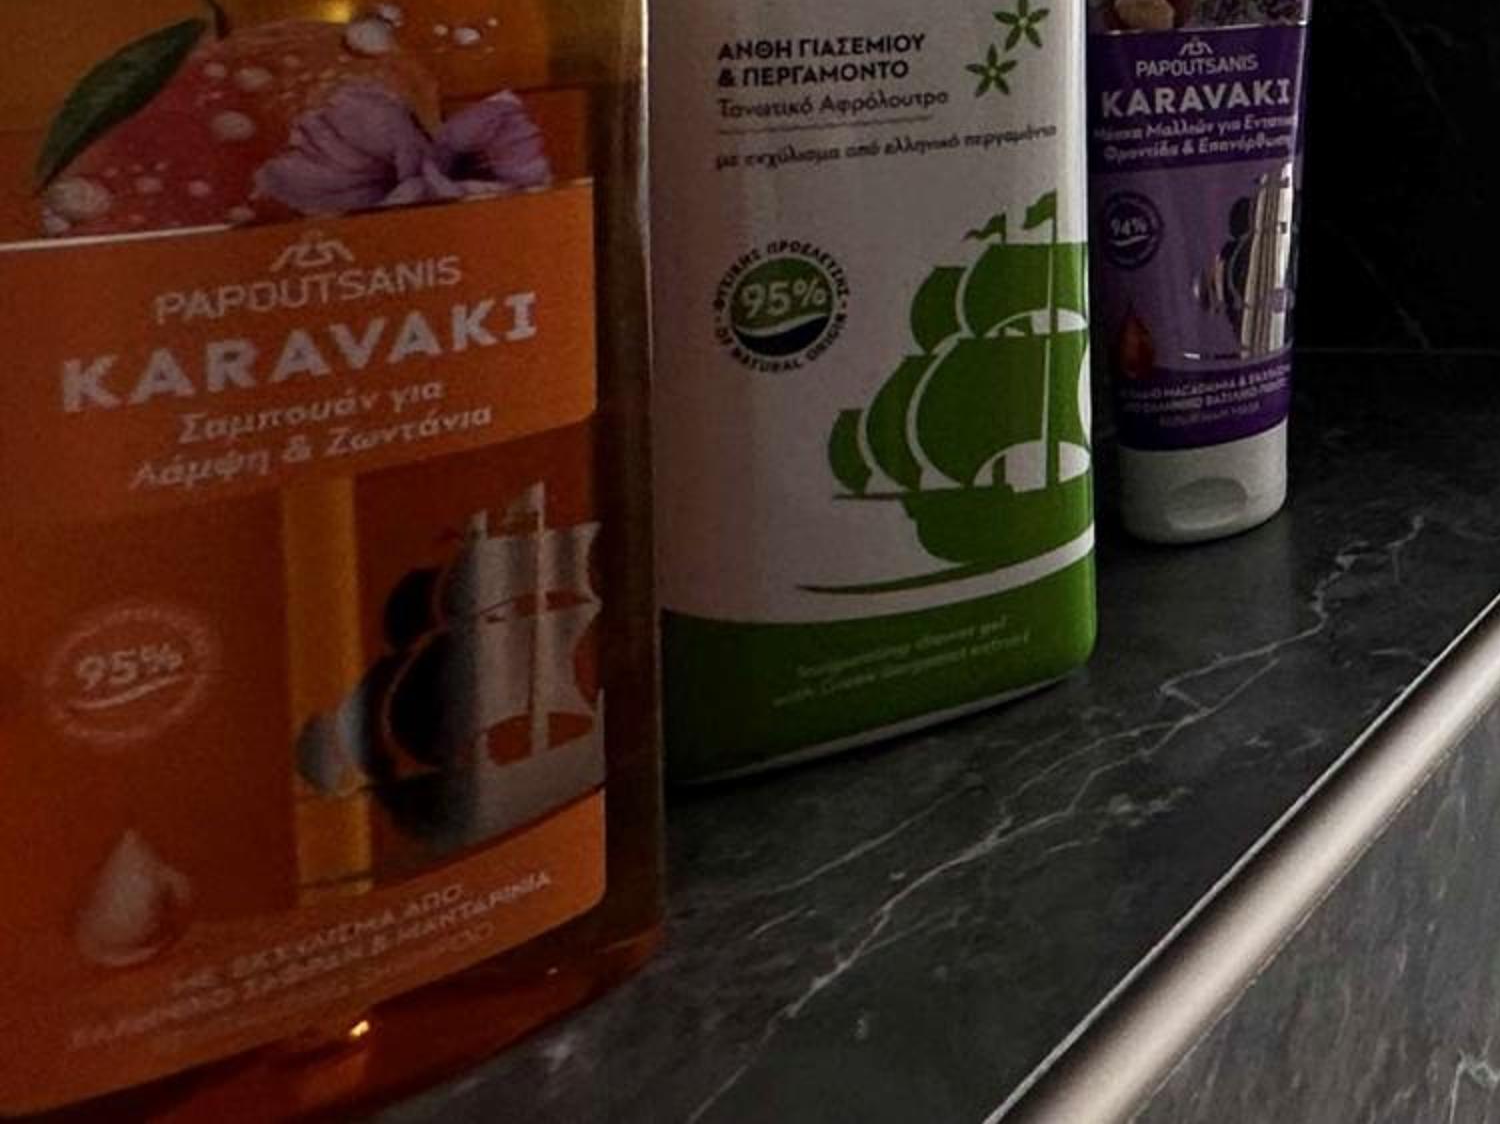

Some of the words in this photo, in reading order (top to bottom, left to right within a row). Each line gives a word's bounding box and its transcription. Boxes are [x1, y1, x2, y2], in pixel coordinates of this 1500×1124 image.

[717, 39, 792, 61] ΑΝΘΗ
[798, 33, 927, 59] ΓΙΑΣΕΜΙΟΥ
[1135, 53, 1260, 78] PAPOUTSANIS
[717, 67, 736, 88] &
[742, 59, 910, 88] ΠΕΡΓΑΜΟΝΤΟ
[1101, 77, 1292, 119] KARAVAKI
[153, 255, 463, 326] PAPOUTSANIS
[740, 276, 828, 320] 95%
[61, 290, 540, 413] KARAVAKI
[177, 387, 381, 444] Σαμπουάν
[389, 382, 446, 414] για
[281, 433, 314, 464] &
[323, 404, 493, 457] Ζωντάνια
[75, 642, 184, 691] 95%
